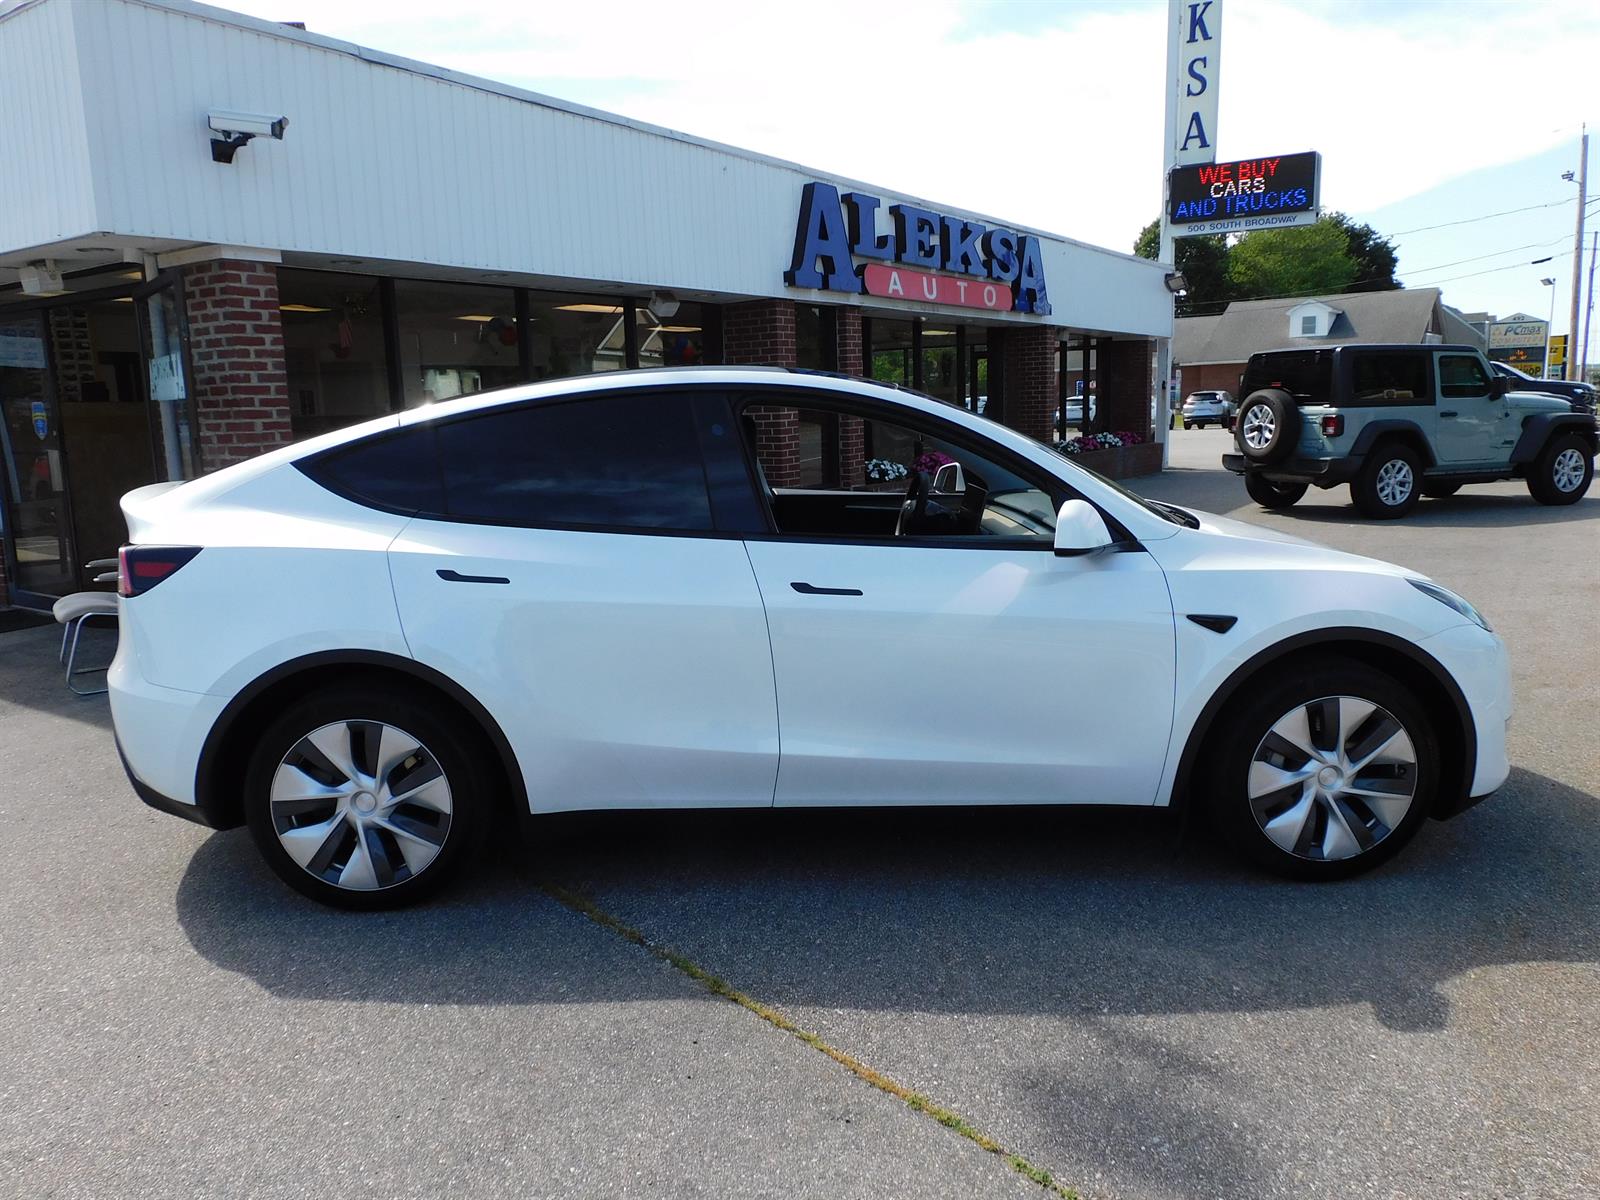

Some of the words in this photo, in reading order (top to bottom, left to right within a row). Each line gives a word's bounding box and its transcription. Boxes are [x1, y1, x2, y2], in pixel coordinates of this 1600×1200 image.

[1199, 163, 1232, 184] WE
[1238, 158, 1280, 180] BUY
[1210, 177, 1265, 198] CARS
[1175, 198, 1217, 218] AND
[1224, 188, 1307, 213] TRUCKS
[1187, 224, 1205, 233] 500
[1209, 220, 1241, 231] SOUTH
[1245, 215, 1298, 227] BROADWAY
[783, 181, 1052, 316] ALEKSA
[888, 271, 997, 307] AUTO
